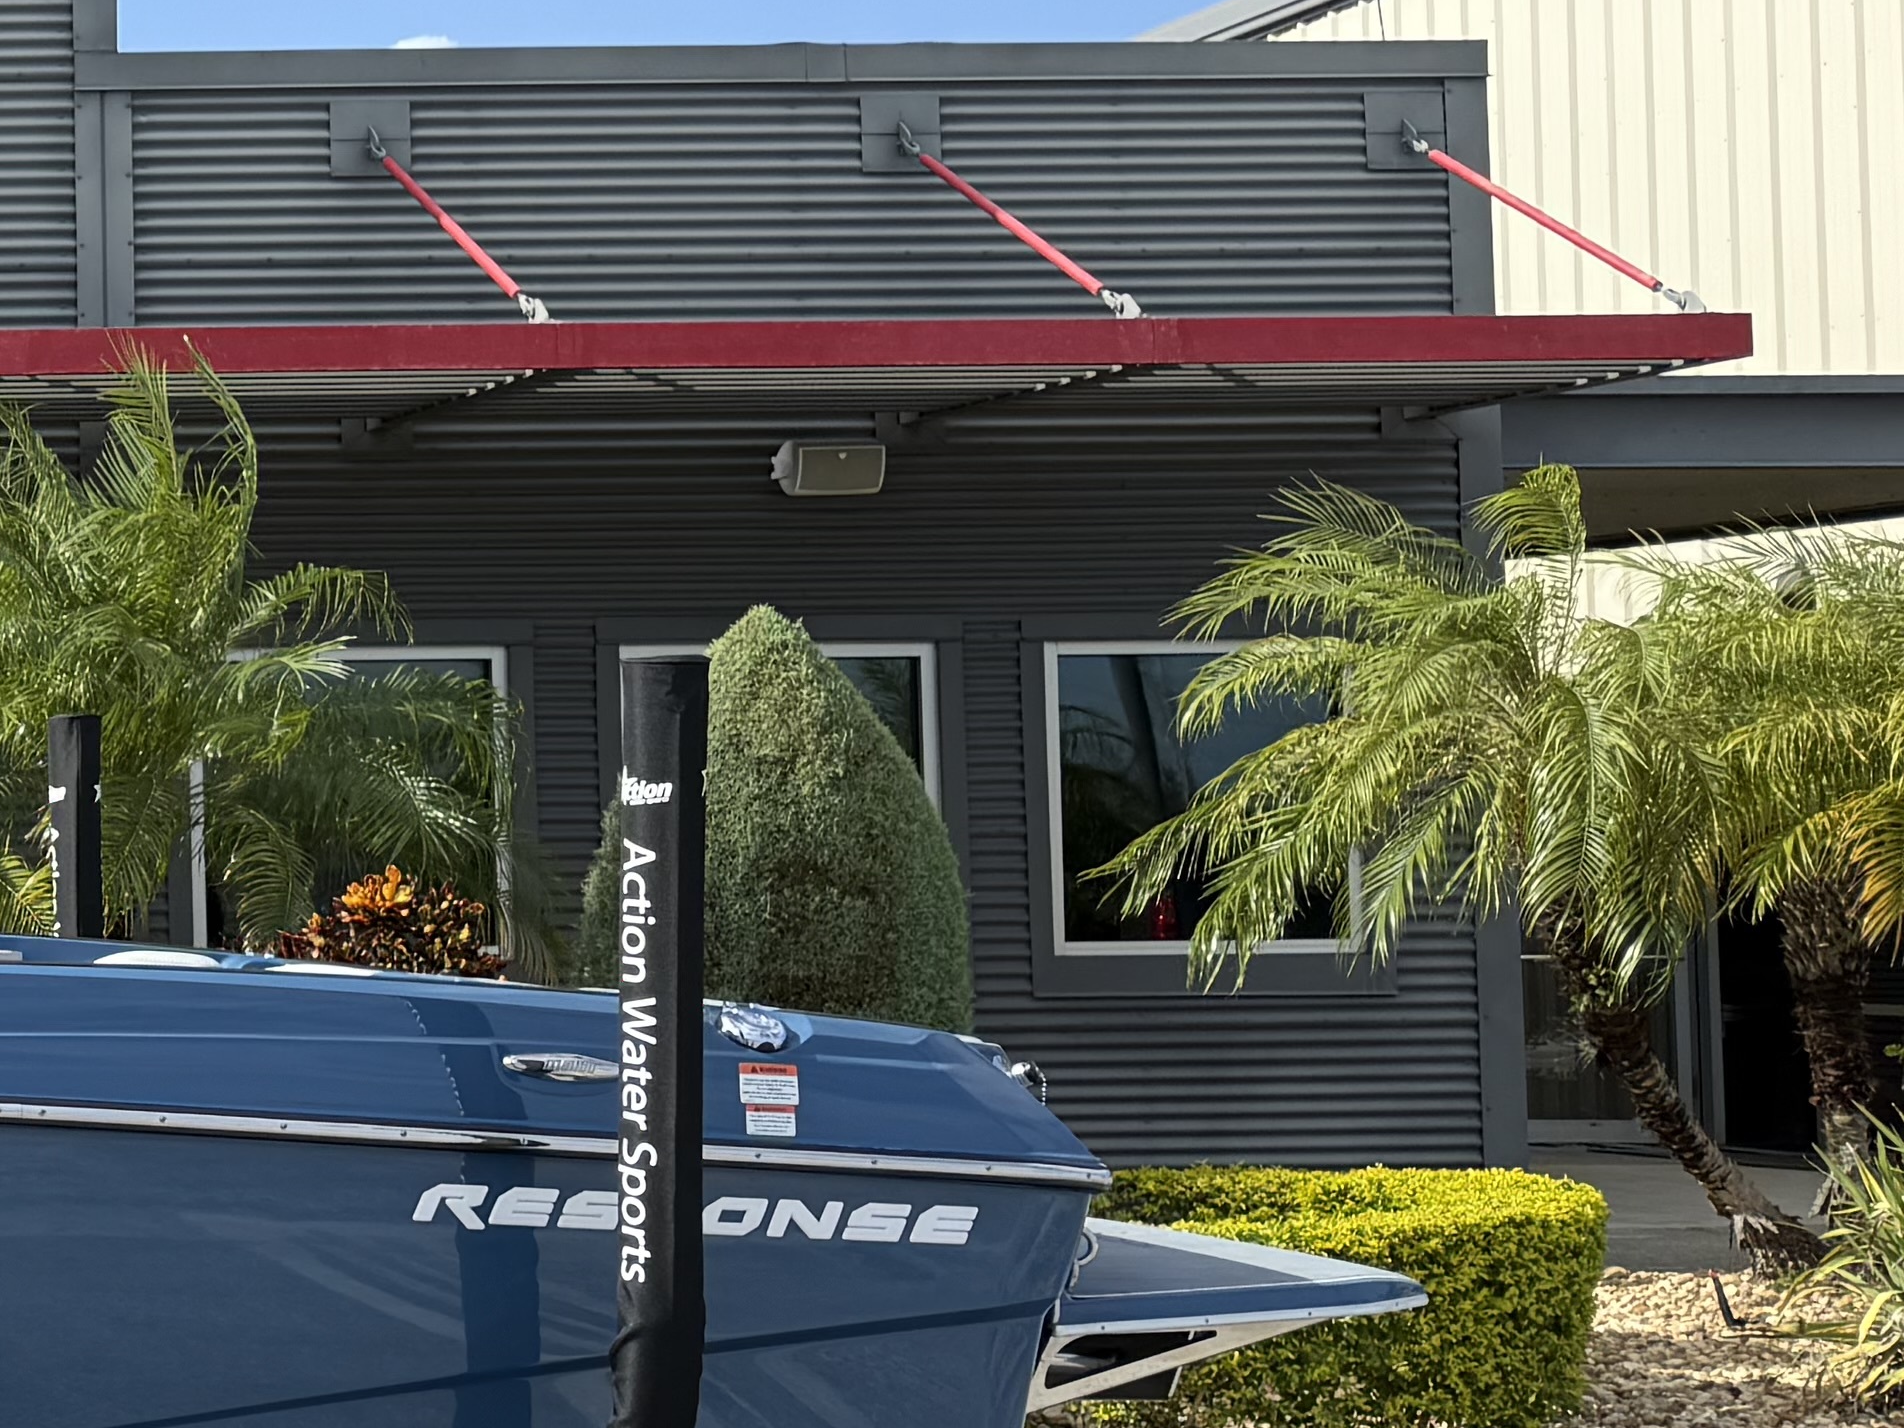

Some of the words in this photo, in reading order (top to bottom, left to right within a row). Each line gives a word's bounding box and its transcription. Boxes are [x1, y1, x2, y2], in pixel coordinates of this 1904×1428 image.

[621, 837, 657, 984] Action
[621, 997, 658, 1132] Water
[412, 1183, 979, 1245] RESONSE
[617, 1137, 659, 1284] Sports
